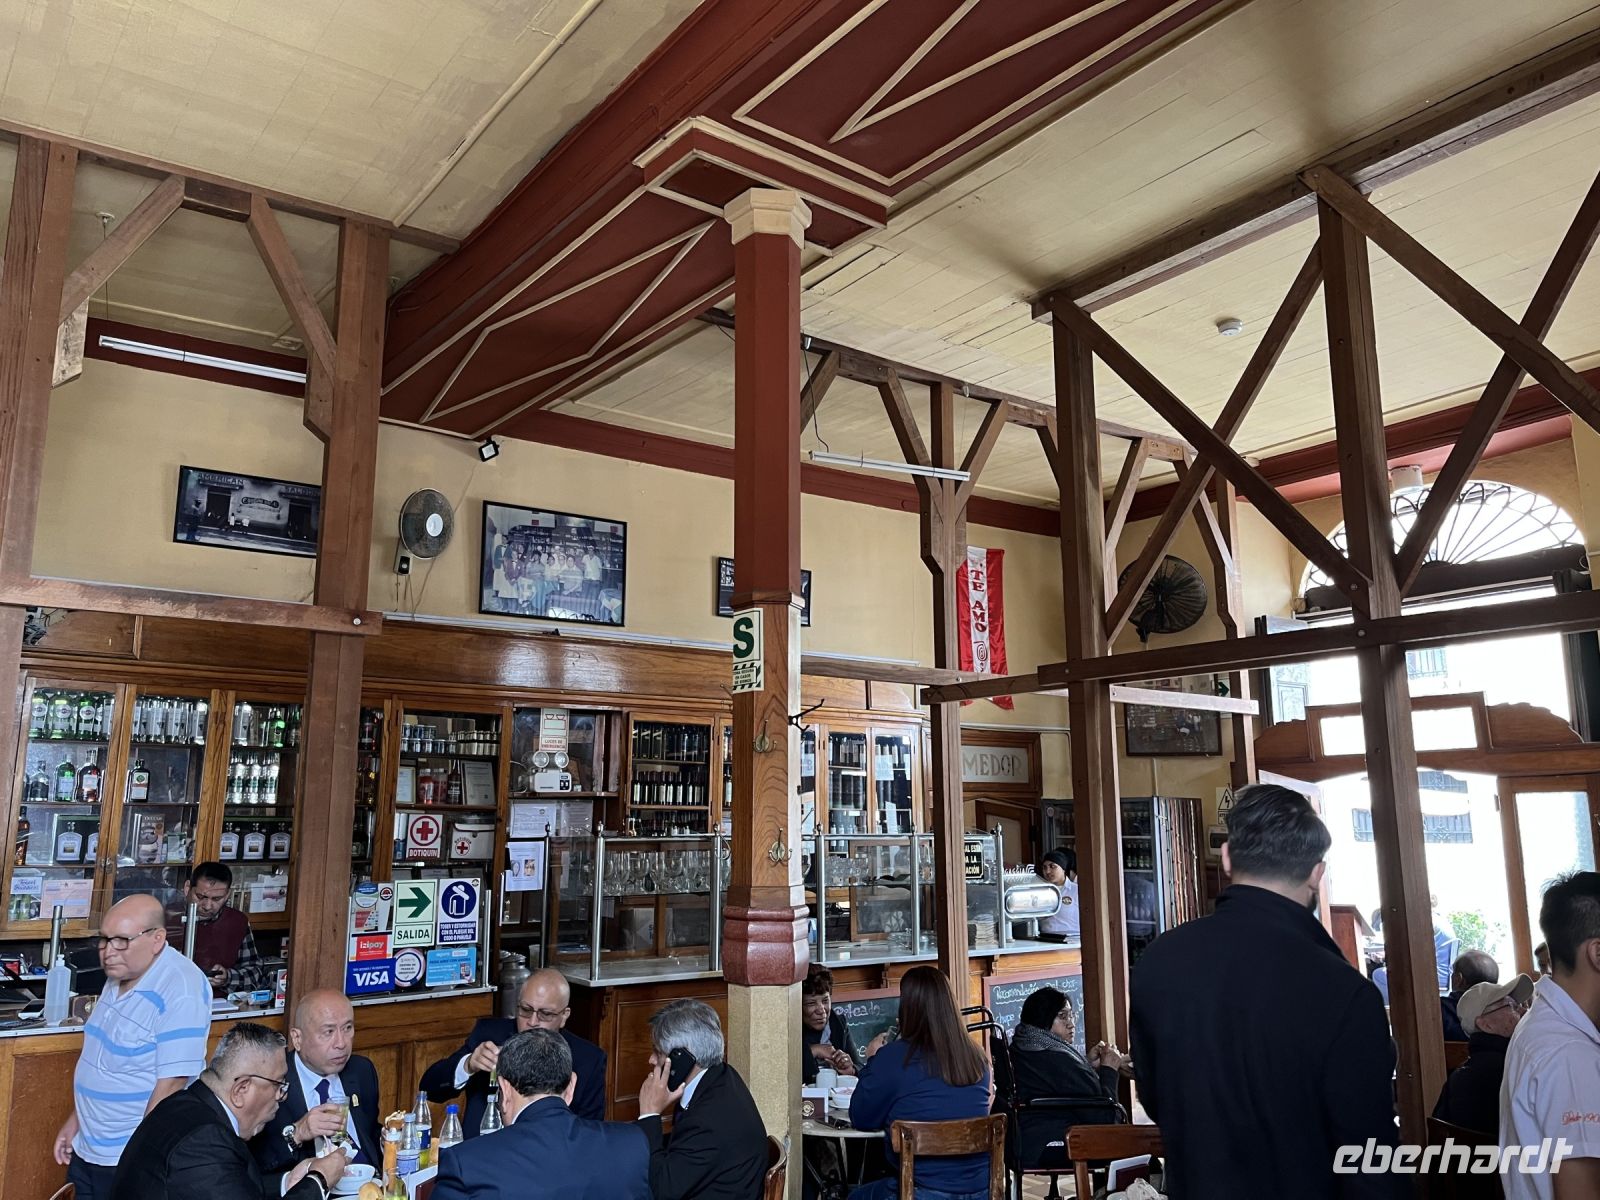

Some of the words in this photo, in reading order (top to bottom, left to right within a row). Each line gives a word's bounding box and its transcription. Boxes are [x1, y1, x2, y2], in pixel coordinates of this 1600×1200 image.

[970, 569, 985, 593] TE
[971, 600, 987, 633] AMO
[733, 616, 755, 659] S
[962, 752, 1022, 777] MEDOR
[409, 848, 438, 857] BOTIQUIN
[397, 929, 430, 940] SALIDA
[360, 940, 385, 950] izipay
[353, 971, 389, 987] VISA
